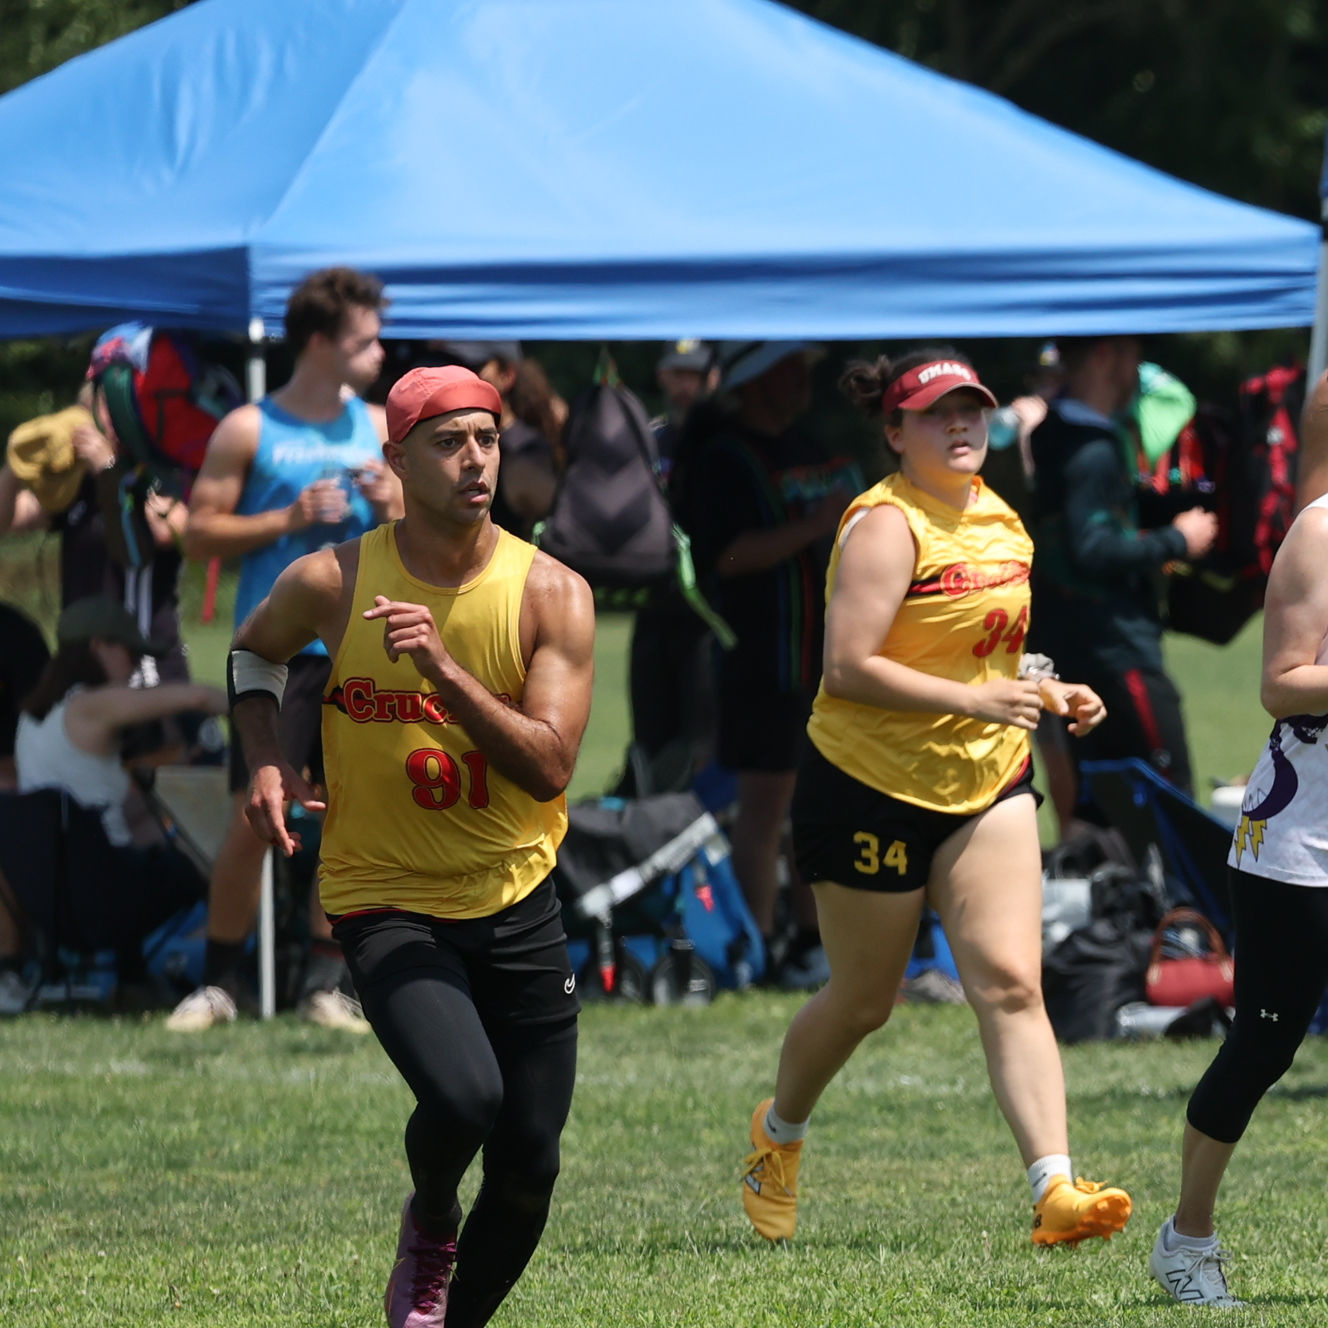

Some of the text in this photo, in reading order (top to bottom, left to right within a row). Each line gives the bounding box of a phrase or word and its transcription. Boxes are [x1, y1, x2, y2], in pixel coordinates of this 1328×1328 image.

[972, 604, 1027, 658] 34
[405, 747, 490, 811] 91
[852, 830, 908, 876] 34
